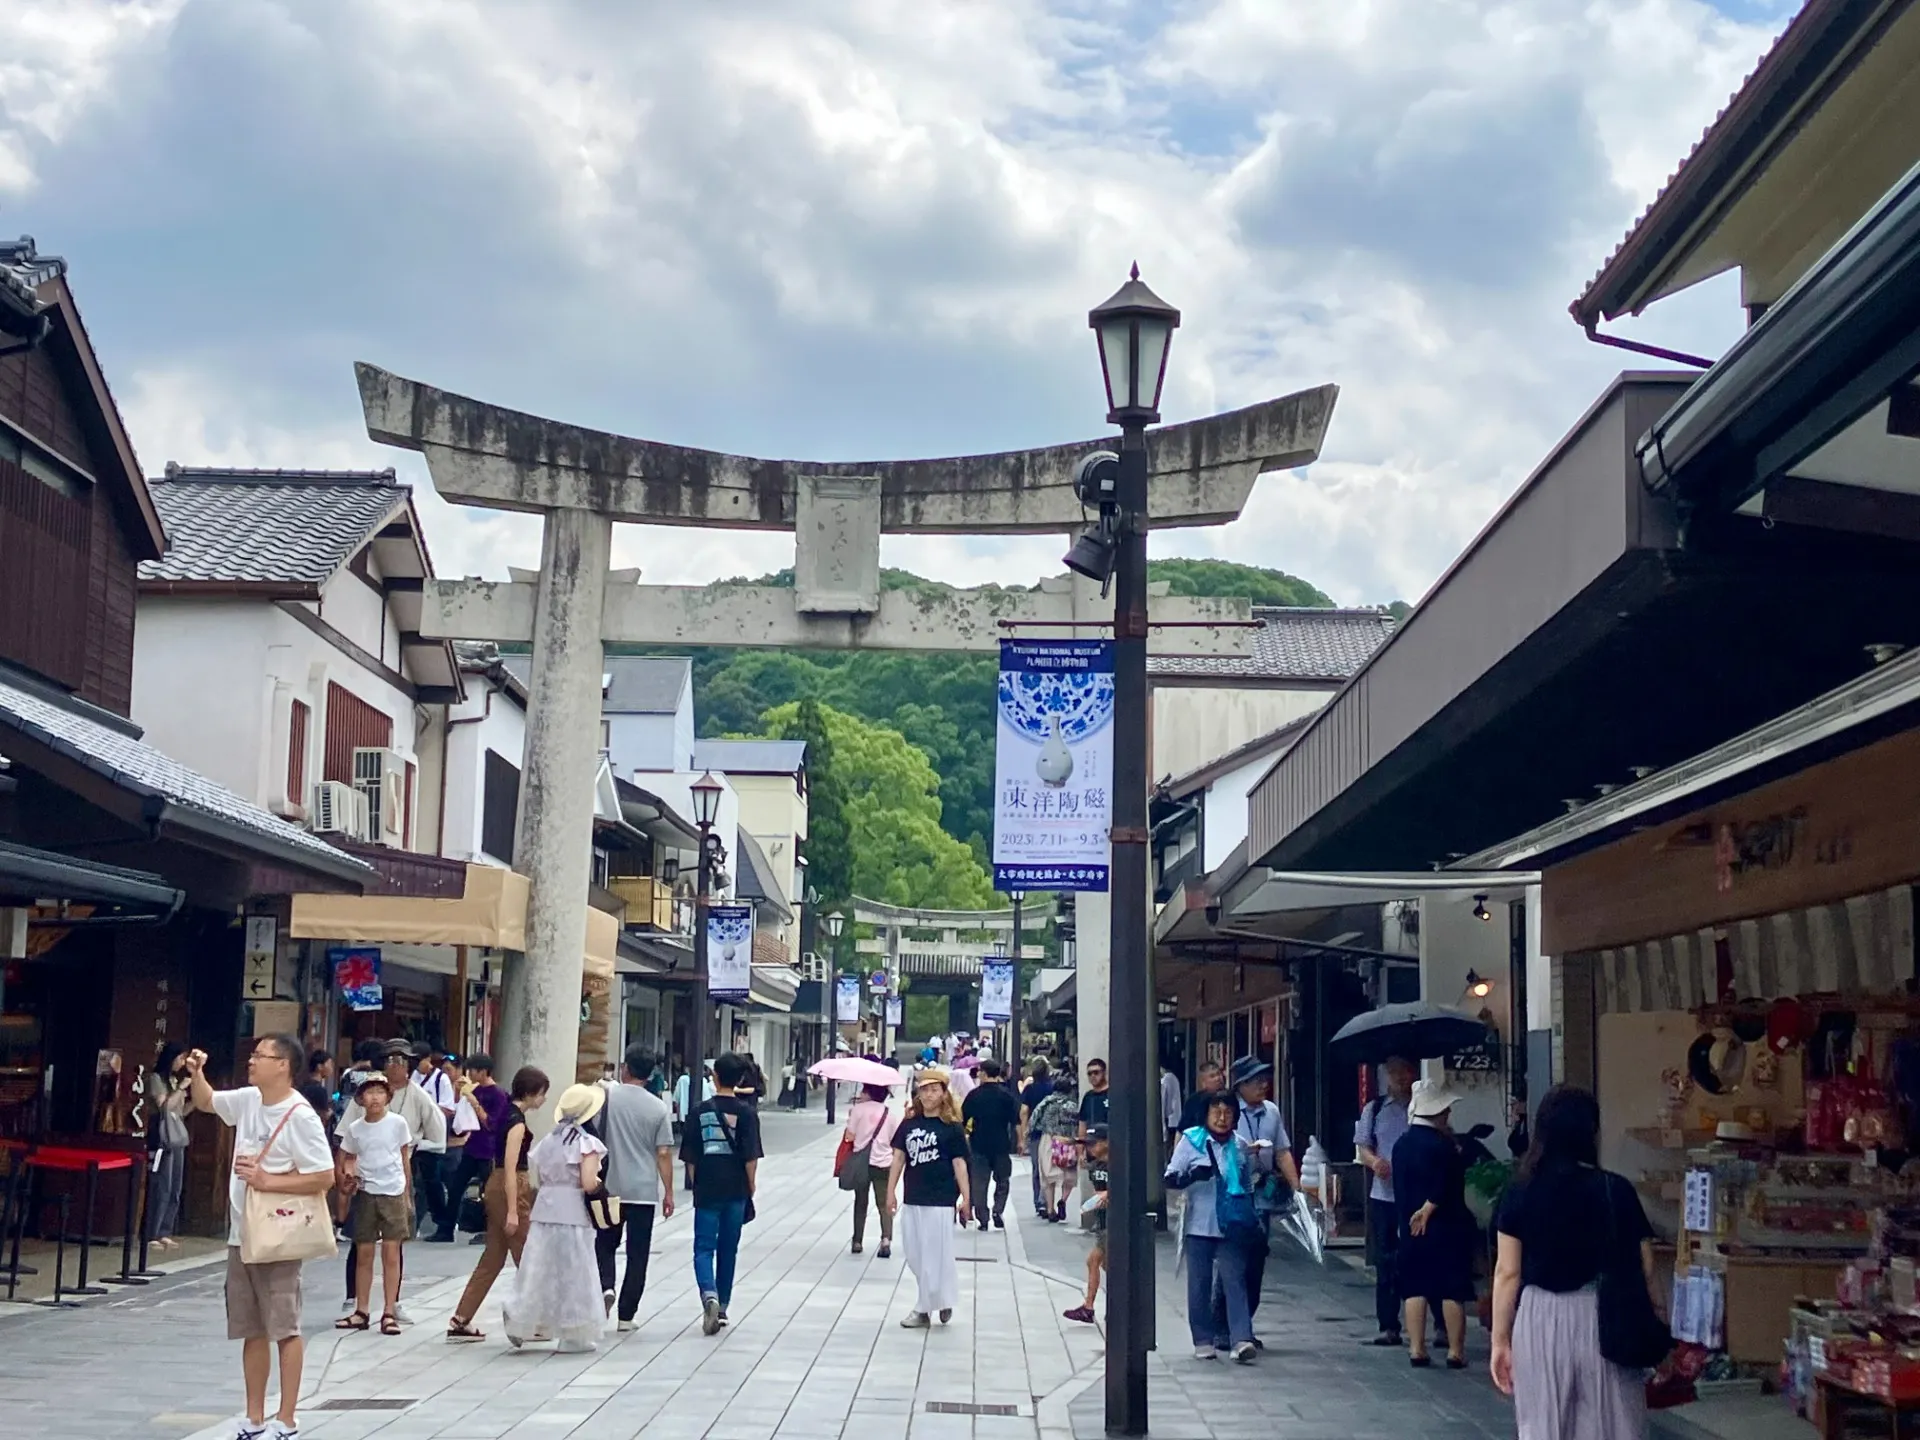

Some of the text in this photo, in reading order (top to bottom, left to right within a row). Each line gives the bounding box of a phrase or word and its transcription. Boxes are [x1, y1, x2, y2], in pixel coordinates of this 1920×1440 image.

[1039, 647, 1072, 656] NATIONAL
[1073, 647, 1101, 656] MUSEUM
[1026, 656, 1089, 668] 九州国立博物館
[1007, 785, 1106, 813] 東洋陶磁
